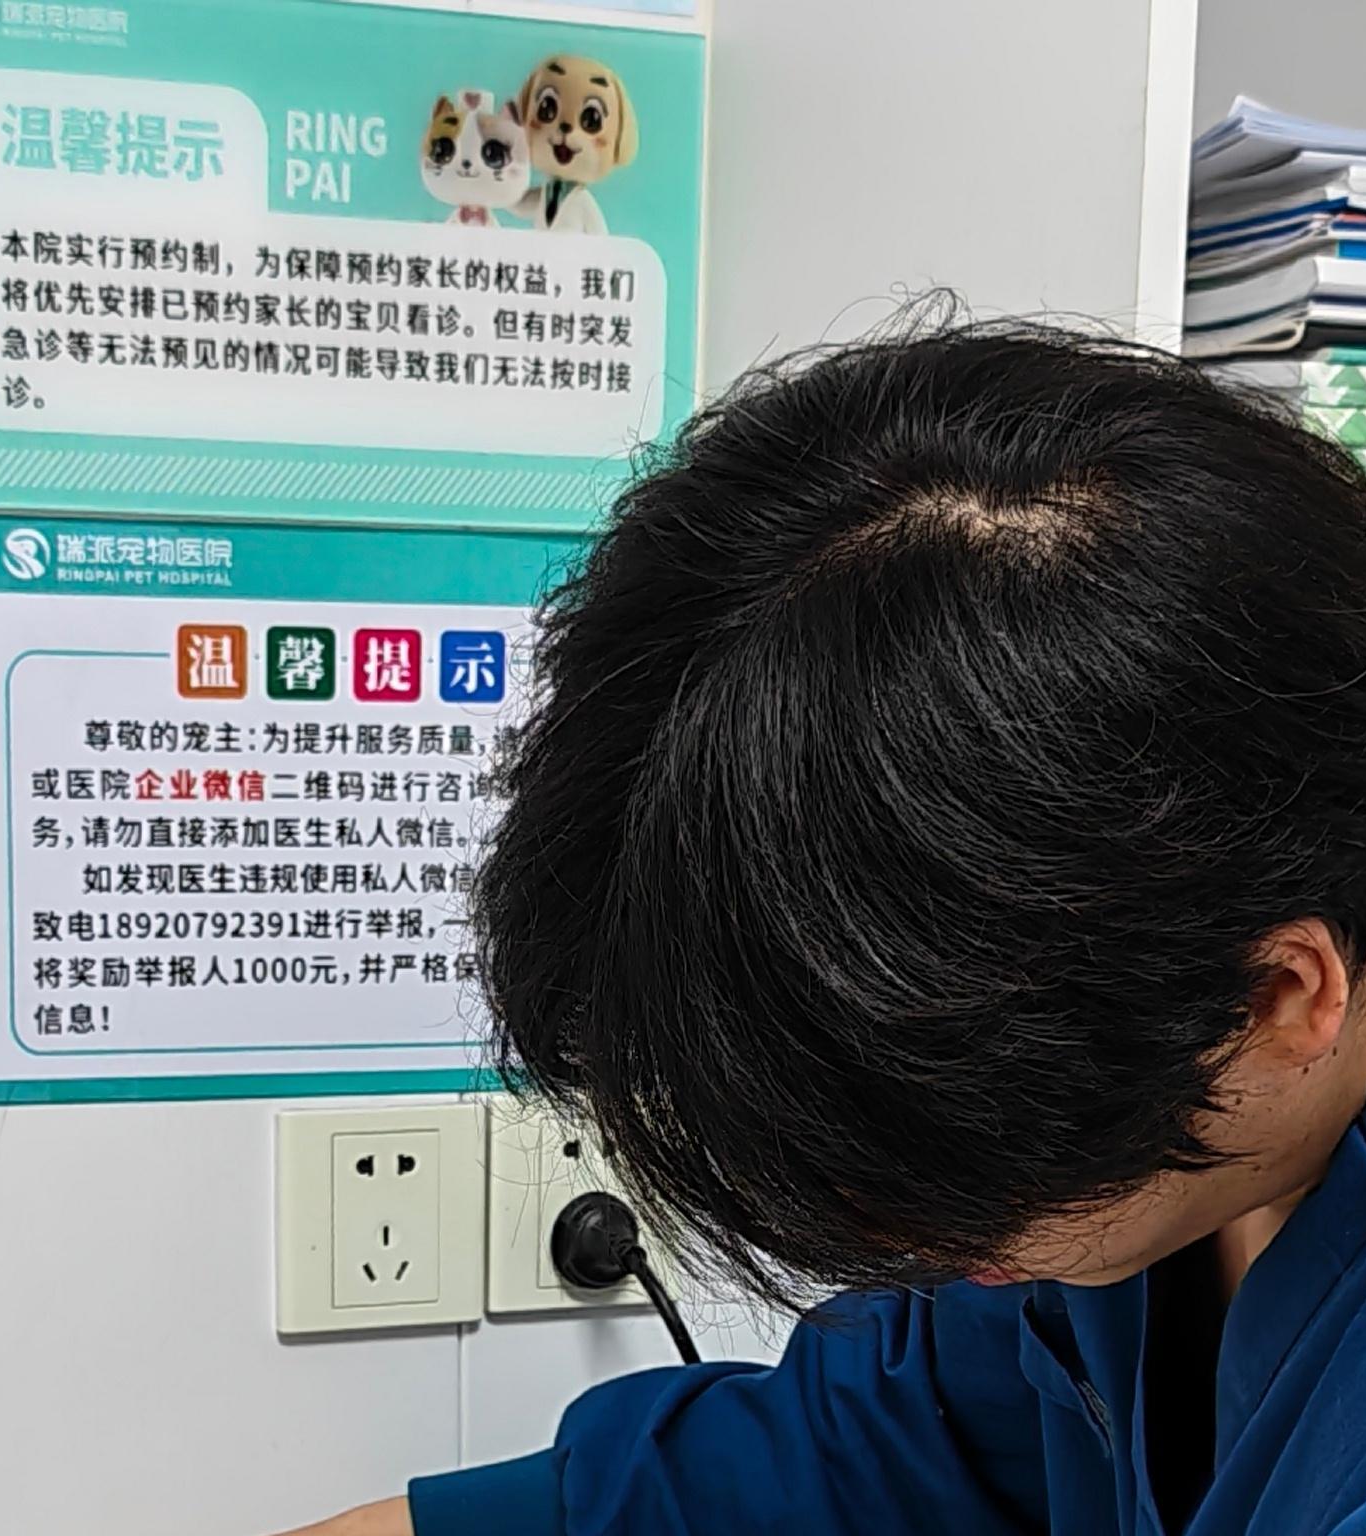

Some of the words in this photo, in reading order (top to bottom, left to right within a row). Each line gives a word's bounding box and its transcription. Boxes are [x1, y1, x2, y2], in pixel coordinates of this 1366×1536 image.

[0, 103, 225, 183] 温馨提示
[288, 110, 388, 157] RING
[286, 157, 351, 204] PAI
[1, 326, 632, 393] 急诊等无法预见的情况可能导致我们无法按时接
[56, 534, 232, 567] 瑞派宠物医院
[57, 568, 119, 583] RINGPAI
[125, 570, 153, 585] PET
[159, 570, 232, 587] HOSPITAL
[32, 815, 468, 848] 务，请勿直接添加医生私人微信。
[83, 862, 475, 895] 如发现医生违规使用私人微信
[34, 1004, 110, 1034] 信息！
